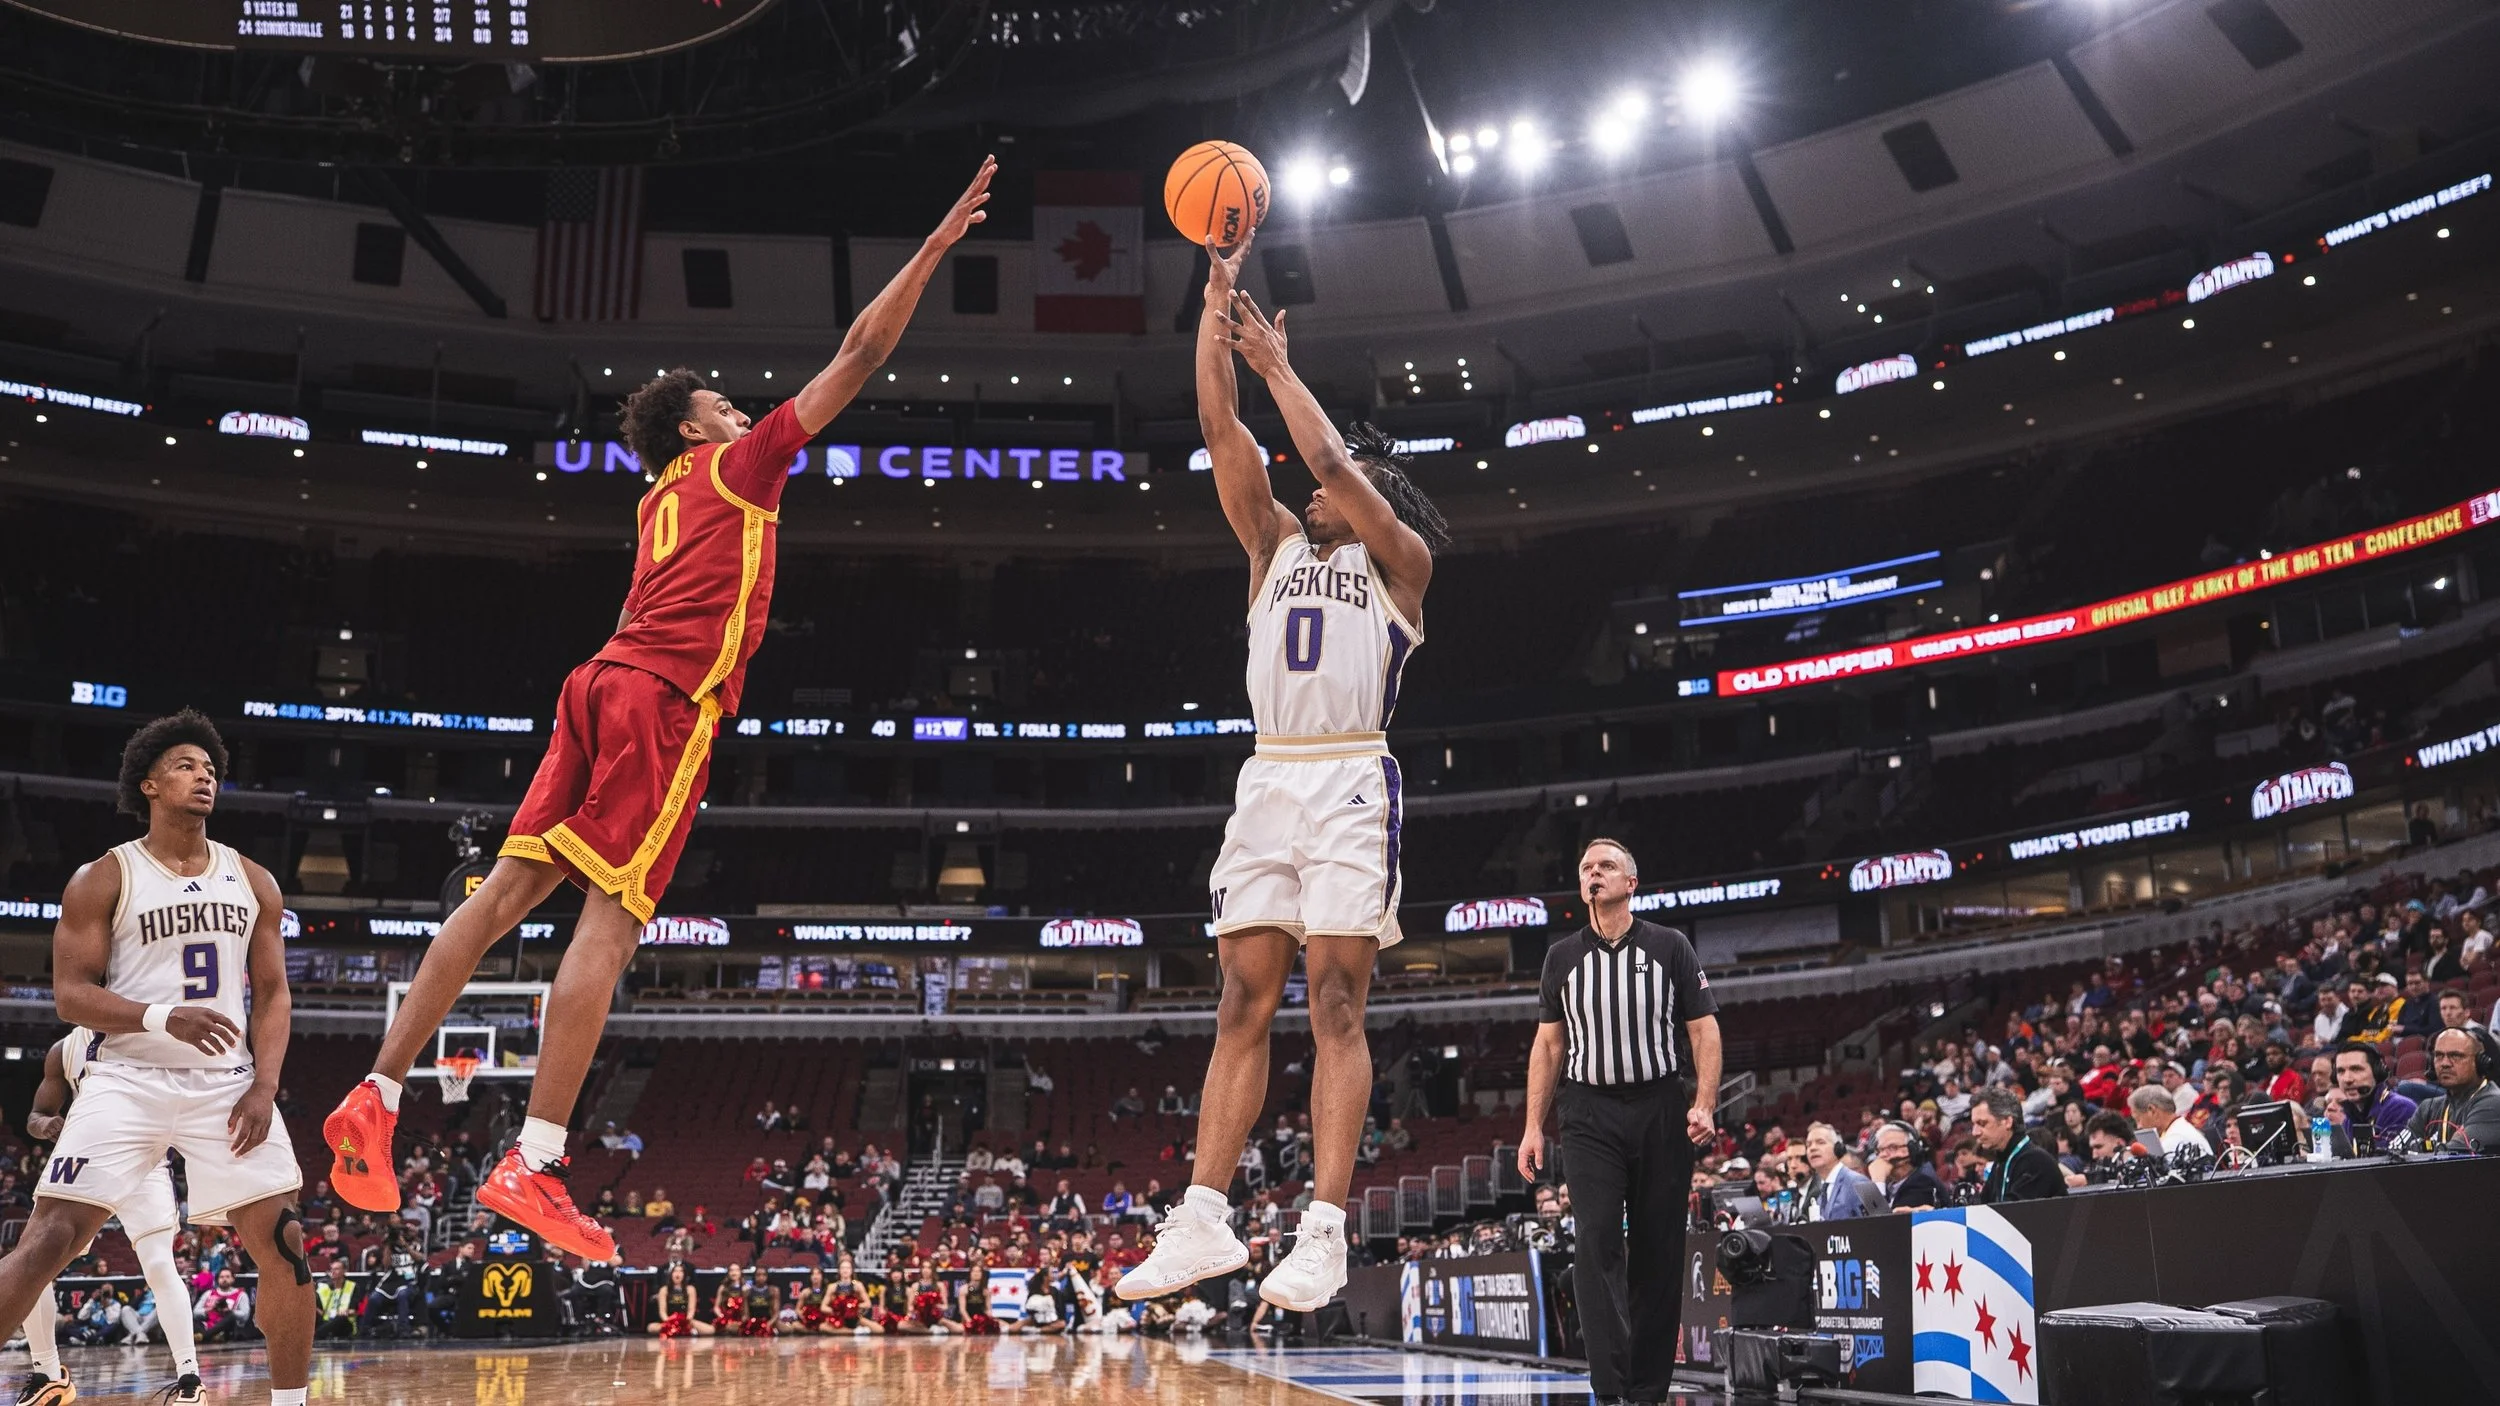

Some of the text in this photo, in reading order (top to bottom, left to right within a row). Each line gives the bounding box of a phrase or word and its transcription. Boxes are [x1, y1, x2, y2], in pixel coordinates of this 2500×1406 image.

[2325, 173, 2492, 246] WHAT'S YOUR BEEF?
[1965, 307, 2114, 357] WHAT'S YOUR BEEF?
[0, 379, 143, 417] HAT'S YOUR BEEF?
[1632, 390, 1773, 424] WHAT'S YOUR BEEF?
[362, 429, 508, 456] WHAT'S YOUR BEEF?
[878, 445, 1125, 481] CENTER
[652, 490, 679, 564] 0
[2091, 595, 2151, 627] OFFICIAL
[2152, 586, 2187, 612] BEEF
[2187, 570, 2235, 601] JERKY
[2236, 565, 2257, 588] OF
[2260, 557, 2290, 583] THE
[2291, 549, 2320, 574] BIG
[2322, 540, 2356, 566] TEN
[2364, 507, 2463, 555] CONFERENCE
[1829, 575, 1898, 601] TOURNAMENT
[1285, 606, 1324, 682] 0
[1733, 667, 1783, 692] OLD
[1783, 647, 1893, 684] TRAPPER
[1911, 632, 1973, 659] WHAT'S
[1972, 626, 2022, 649] YOUR
[2021, 616, 2076, 641] BEEF?
[243, 701, 278, 717] FG%
[325, 706, 366, 723] 3PT%
[366, 708, 411, 726] 41.7%
[411, 711, 443, 727] FT%
[443, 713, 487, 730] 57.1%
[487, 716, 533, 732] BONUS
[737, 718, 762, 735] 49
[786, 718, 831, 736] 15:57
[871, 720, 896, 737] 40
[1002, 722, 1013, 737] 2
[1018, 723, 1060, 738] FOULS
[1066, 723, 1078, 738] 2
[1081, 723, 1126, 738] BONUS
[1144, 722, 1175, 738] FG%
[2417, 730, 2487, 768] WHAT'S
[2252, 771, 2355, 820] OLD TRAPPER
[2010, 810, 2190, 860] WHAT'S YOUR BEEF?
[1850, 854, 1952, 892] OLD TRAPPER
[1628, 878, 1781, 912] HAT'S YOUR BEEF?
[138, 902, 248, 945] HUSKIES
[369, 919, 555, 938] WHAT'S EF?
[638, 916, 730, 945] LD TRAPPER
[794, 924, 972, 941] WHAT'S YOUR BEEF?
[1040, 919, 1143, 947] OLD TRAPPER
[1445, 900, 1548, 932] OLD TRAPPER
[183, 942, 219, 1001] 9
[49, 1156, 89, 1185] W
[478, 1308, 532, 1319] RAM
[1821, 1316, 1849, 1329] BASKETBALL
[1849, 1317, 1883, 1330] TOURNAMENT
